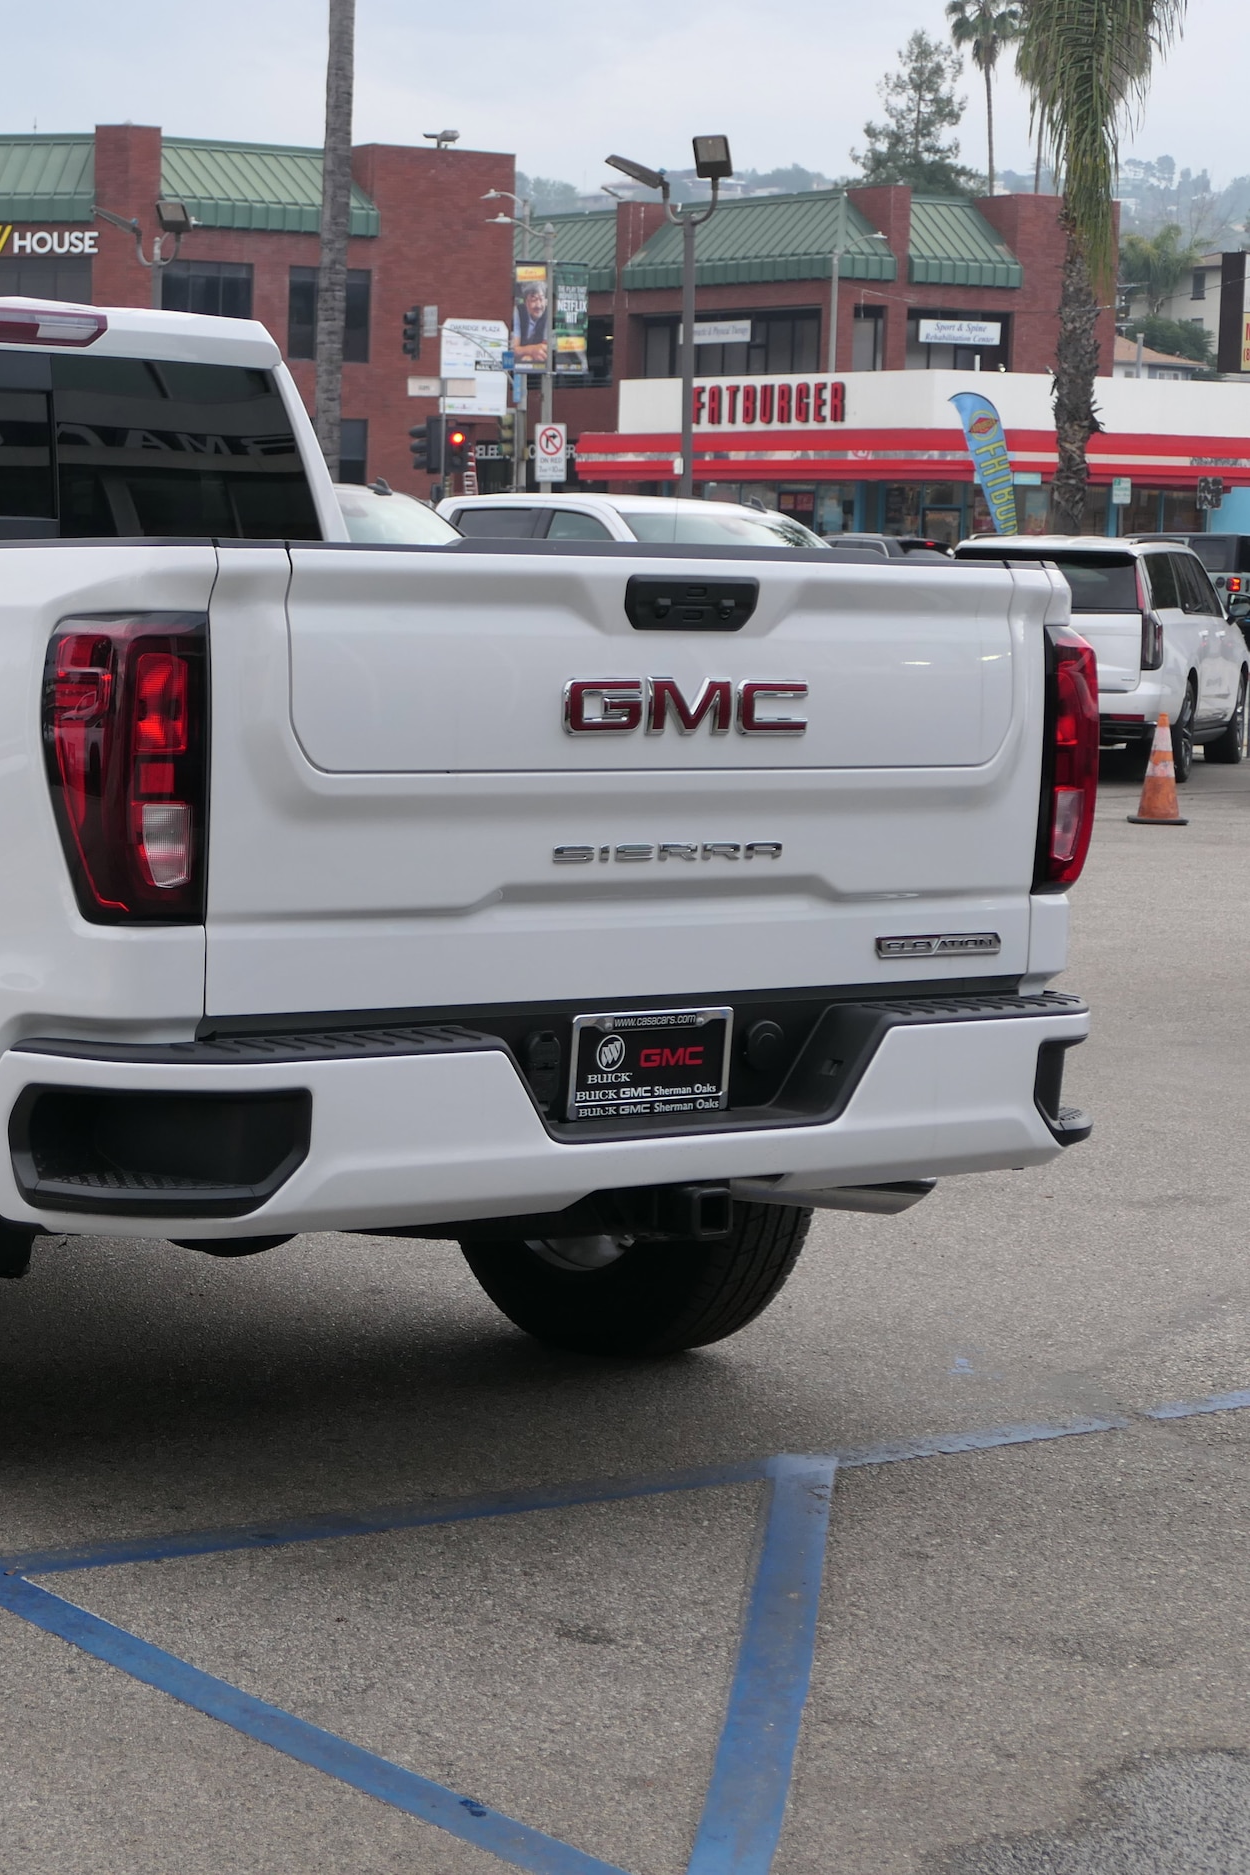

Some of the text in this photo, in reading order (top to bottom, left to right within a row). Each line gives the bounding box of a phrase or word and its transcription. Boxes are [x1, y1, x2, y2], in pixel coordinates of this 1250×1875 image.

[13, 231, 99, 254] HOUSE
[557, 300, 588, 312] NETFLIX
[566, 311, 578, 323] HIT
[935, 322, 987, 334] Sport & Spine
[925, 332, 995, 343] Rehabilitation Center
[693, 381, 846, 425] FATBURGER
[561, 676, 808, 736] GMC
[552, 840, 783, 864] SIERRA
[886, 938, 993, 951] ELEVATION
[614, 1013, 697, 1028] www.casacars.com
[639, 1046, 705, 1068] GMC
[587, 1073, 633, 1084] BUICK
[576, 1083, 717, 1101] BUICK GMC Sherman Oaks
[578, 1098, 720, 1117] BUICK GMC Sherman Oaks
